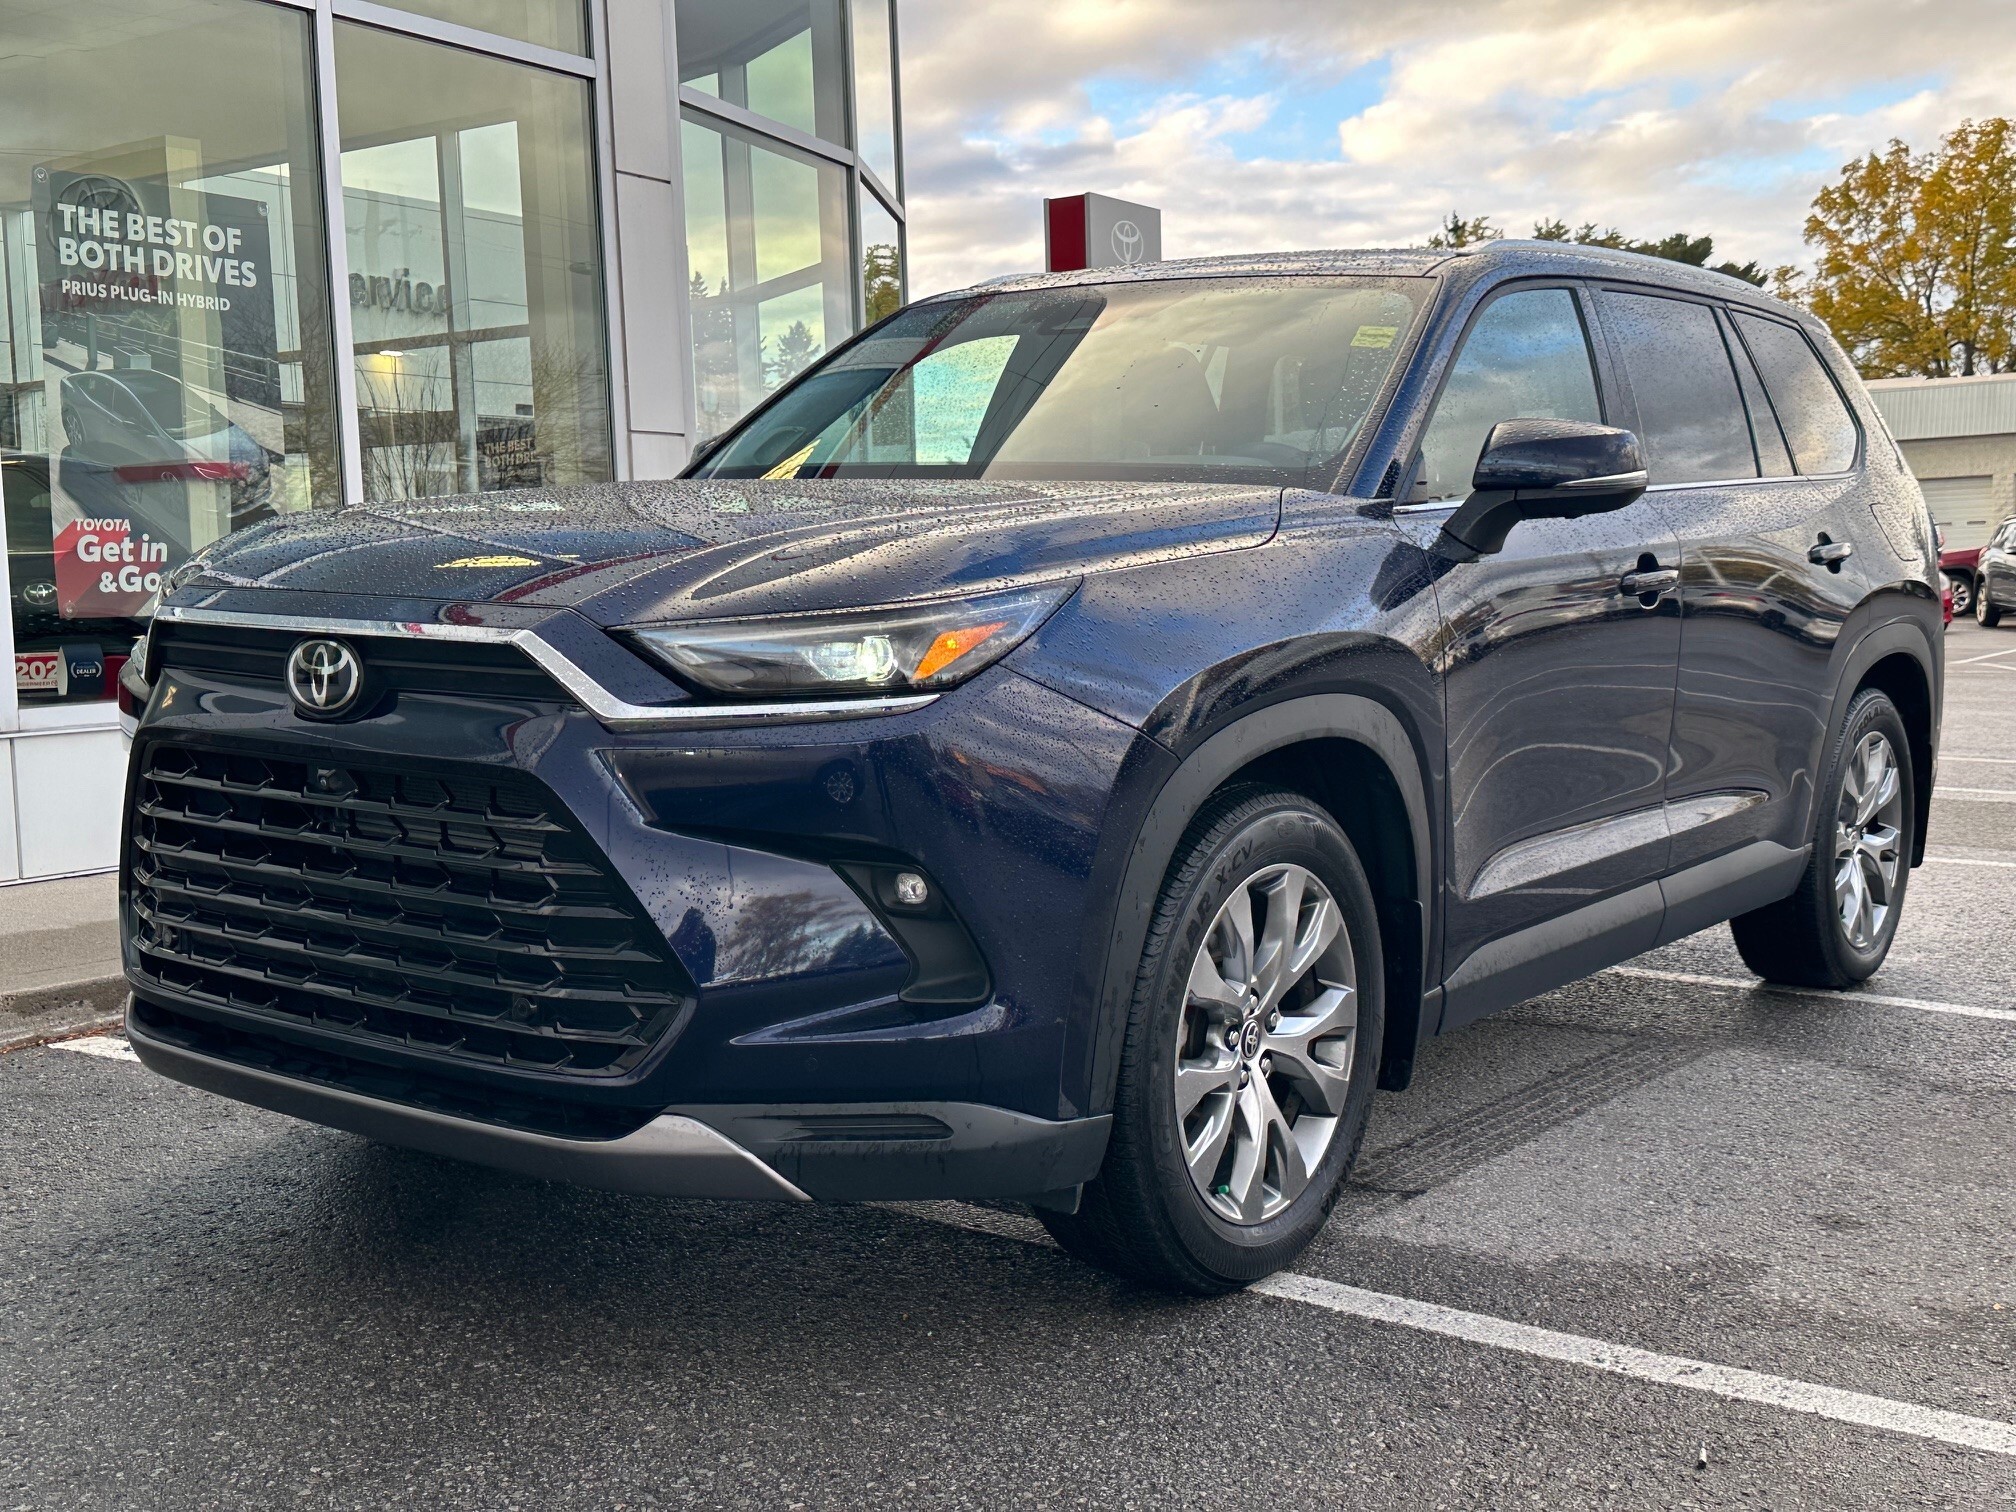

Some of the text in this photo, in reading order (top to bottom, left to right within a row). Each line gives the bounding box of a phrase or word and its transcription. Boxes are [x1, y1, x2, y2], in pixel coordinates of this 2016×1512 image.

[57, 203, 242, 254] THE BEST OF
[59, 237, 257, 287] BOTH DRIVES
[62, 280, 231, 311] PRIUS PLUG-IN HYBRID
[484, 437, 533, 455] THE BEST
[484, 453, 515, 468] BOTH
[75, 518, 131, 532] TOYOTA
[77, 534, 167, 562] Get in
[99, 566, 161, 593] &Go
